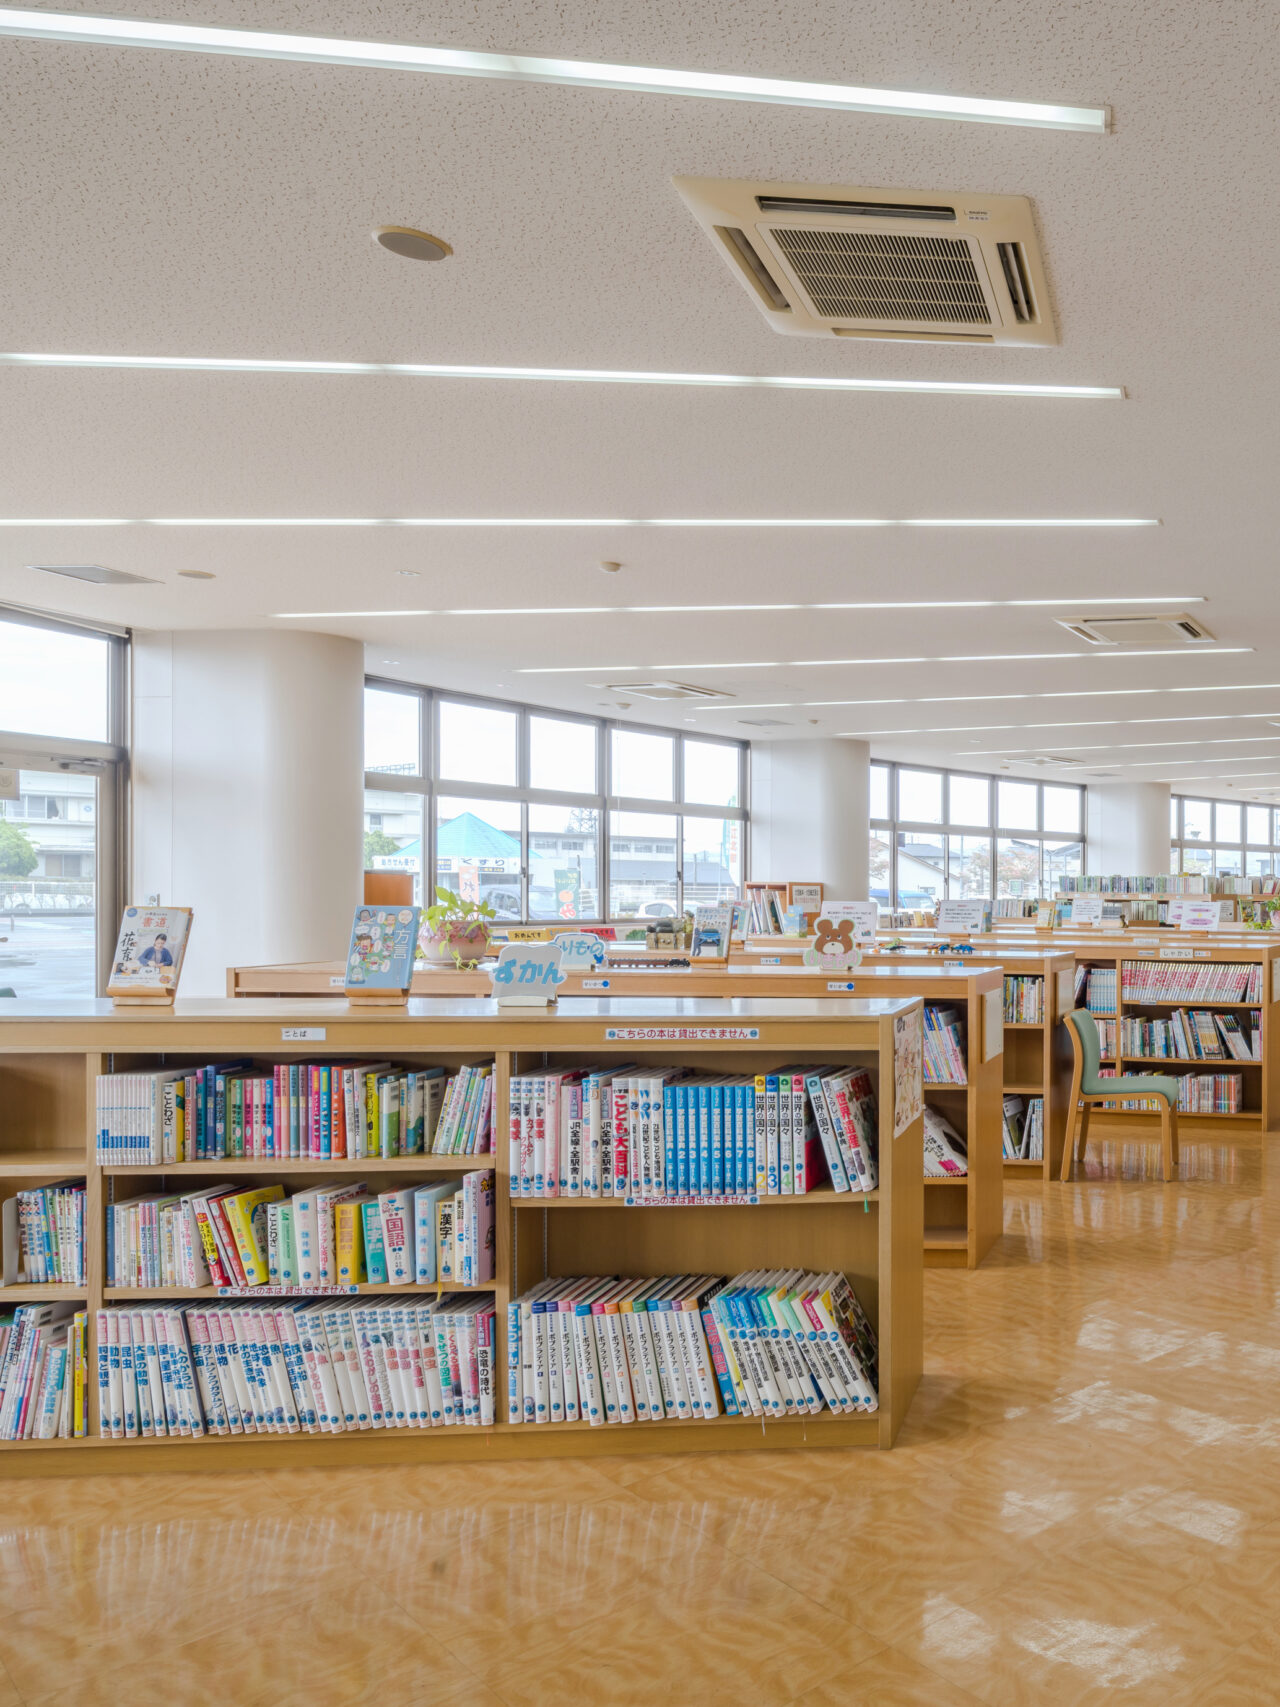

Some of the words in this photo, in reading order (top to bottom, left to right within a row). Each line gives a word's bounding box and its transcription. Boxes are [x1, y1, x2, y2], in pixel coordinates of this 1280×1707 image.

[394, 929, 411, 959] 方言
[493, 958, 565, 985] ずかん
[284, 1029, 308, 1038] ことば
[617, 1027, 749, 1040] こちらの本は貸出できません
[164, 1083, 174, 1126] ことわざ
[755, 1094, 765, 1136] 世界の国々
[767, 1094, 776, 1136] 世界の国々
[780, 1094, 790, 1136] 世界の国々
[794, 1094, 803, 1136] 世界の国々
[812, 1095, 830, 1136] 世界の国々
[570, 1121, 581, 1176] JR全線・全駅舎
[601, 1121, 612, 1176] JR全線・全駅舎
[614, 1095, 629, 1179] こども大百科
[755, 1174, 766, 1189] 2
[768, 1174, 778, 1189] 3
[780, 1174, 792, 1188] 4
[795, 1174, 803, 1188] 1
[269, 1205, 278, 1248] ことわざ
[386, 1217, 405, 1248] 国語
[439, 1213, 454, 1239] 漢字
[230, 1285, 348, 1296] こちらの本は貸出できません
[110, 1346, 120, 1369] 動物
[121, 1346, 132, 1369] 昆虫
[214, 1343, 229, 1367] 植物
[227, 1344, 240, 1356] 花
[437, 1333, 451, 1387] きせつの図鑑
[177, 1346, 194, 1390] 人のからだ
[478, 1349, 491, 1397] 恐竜の時代
